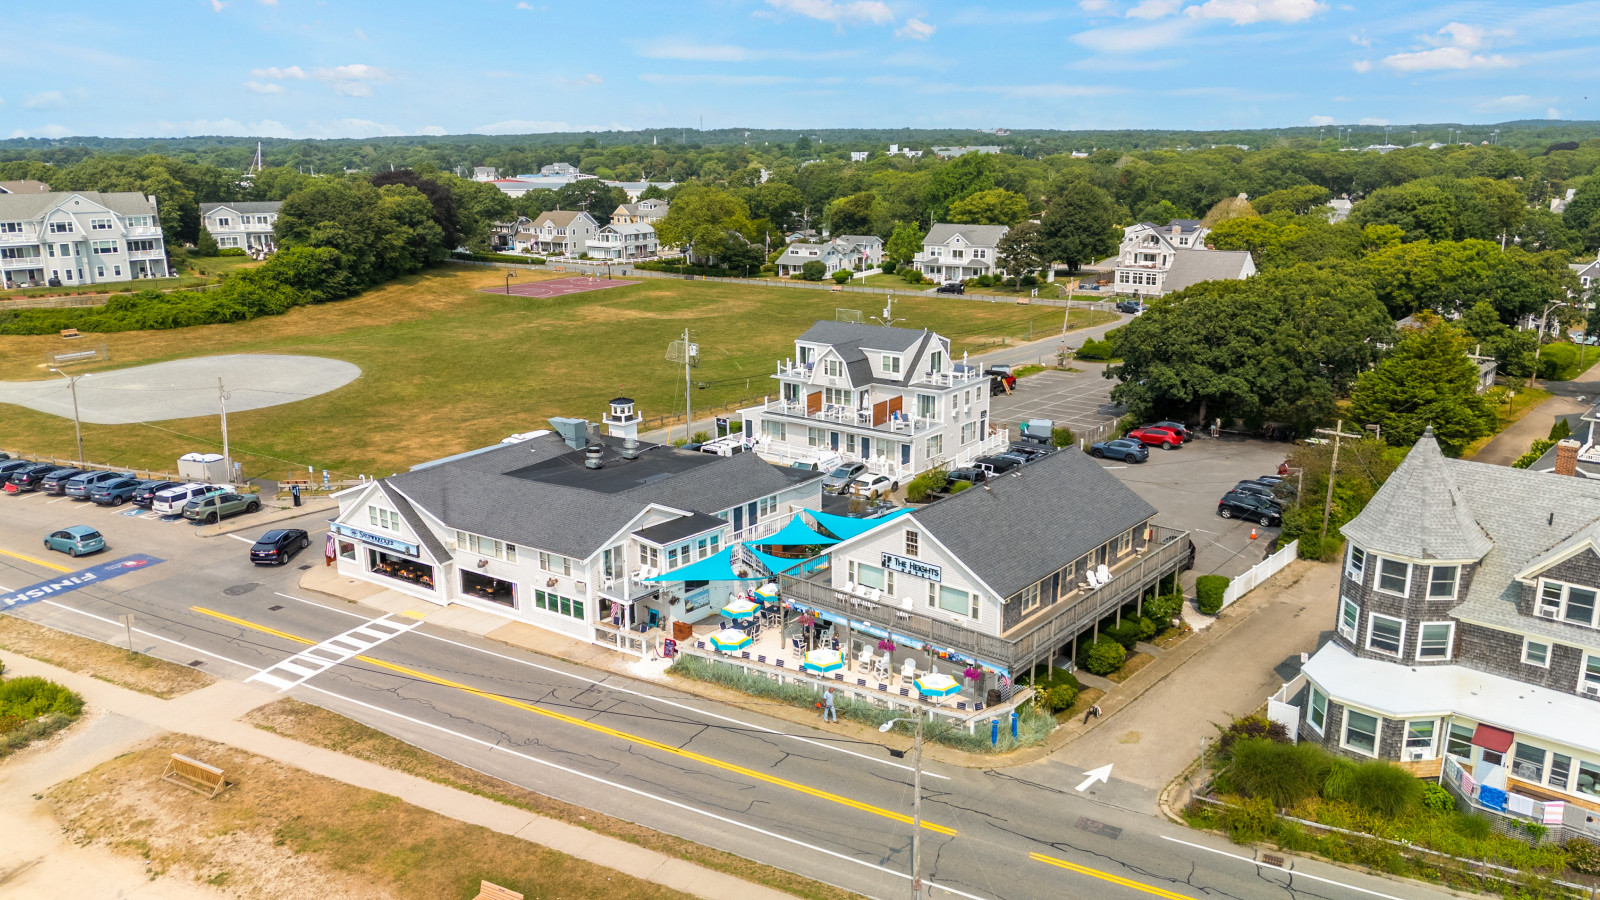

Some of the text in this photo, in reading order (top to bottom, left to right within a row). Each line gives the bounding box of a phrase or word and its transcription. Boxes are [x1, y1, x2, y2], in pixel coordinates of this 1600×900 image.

[894, 557, 940, 577] THE HEIGHTS
[3, 572, 97, 606] FINISH
